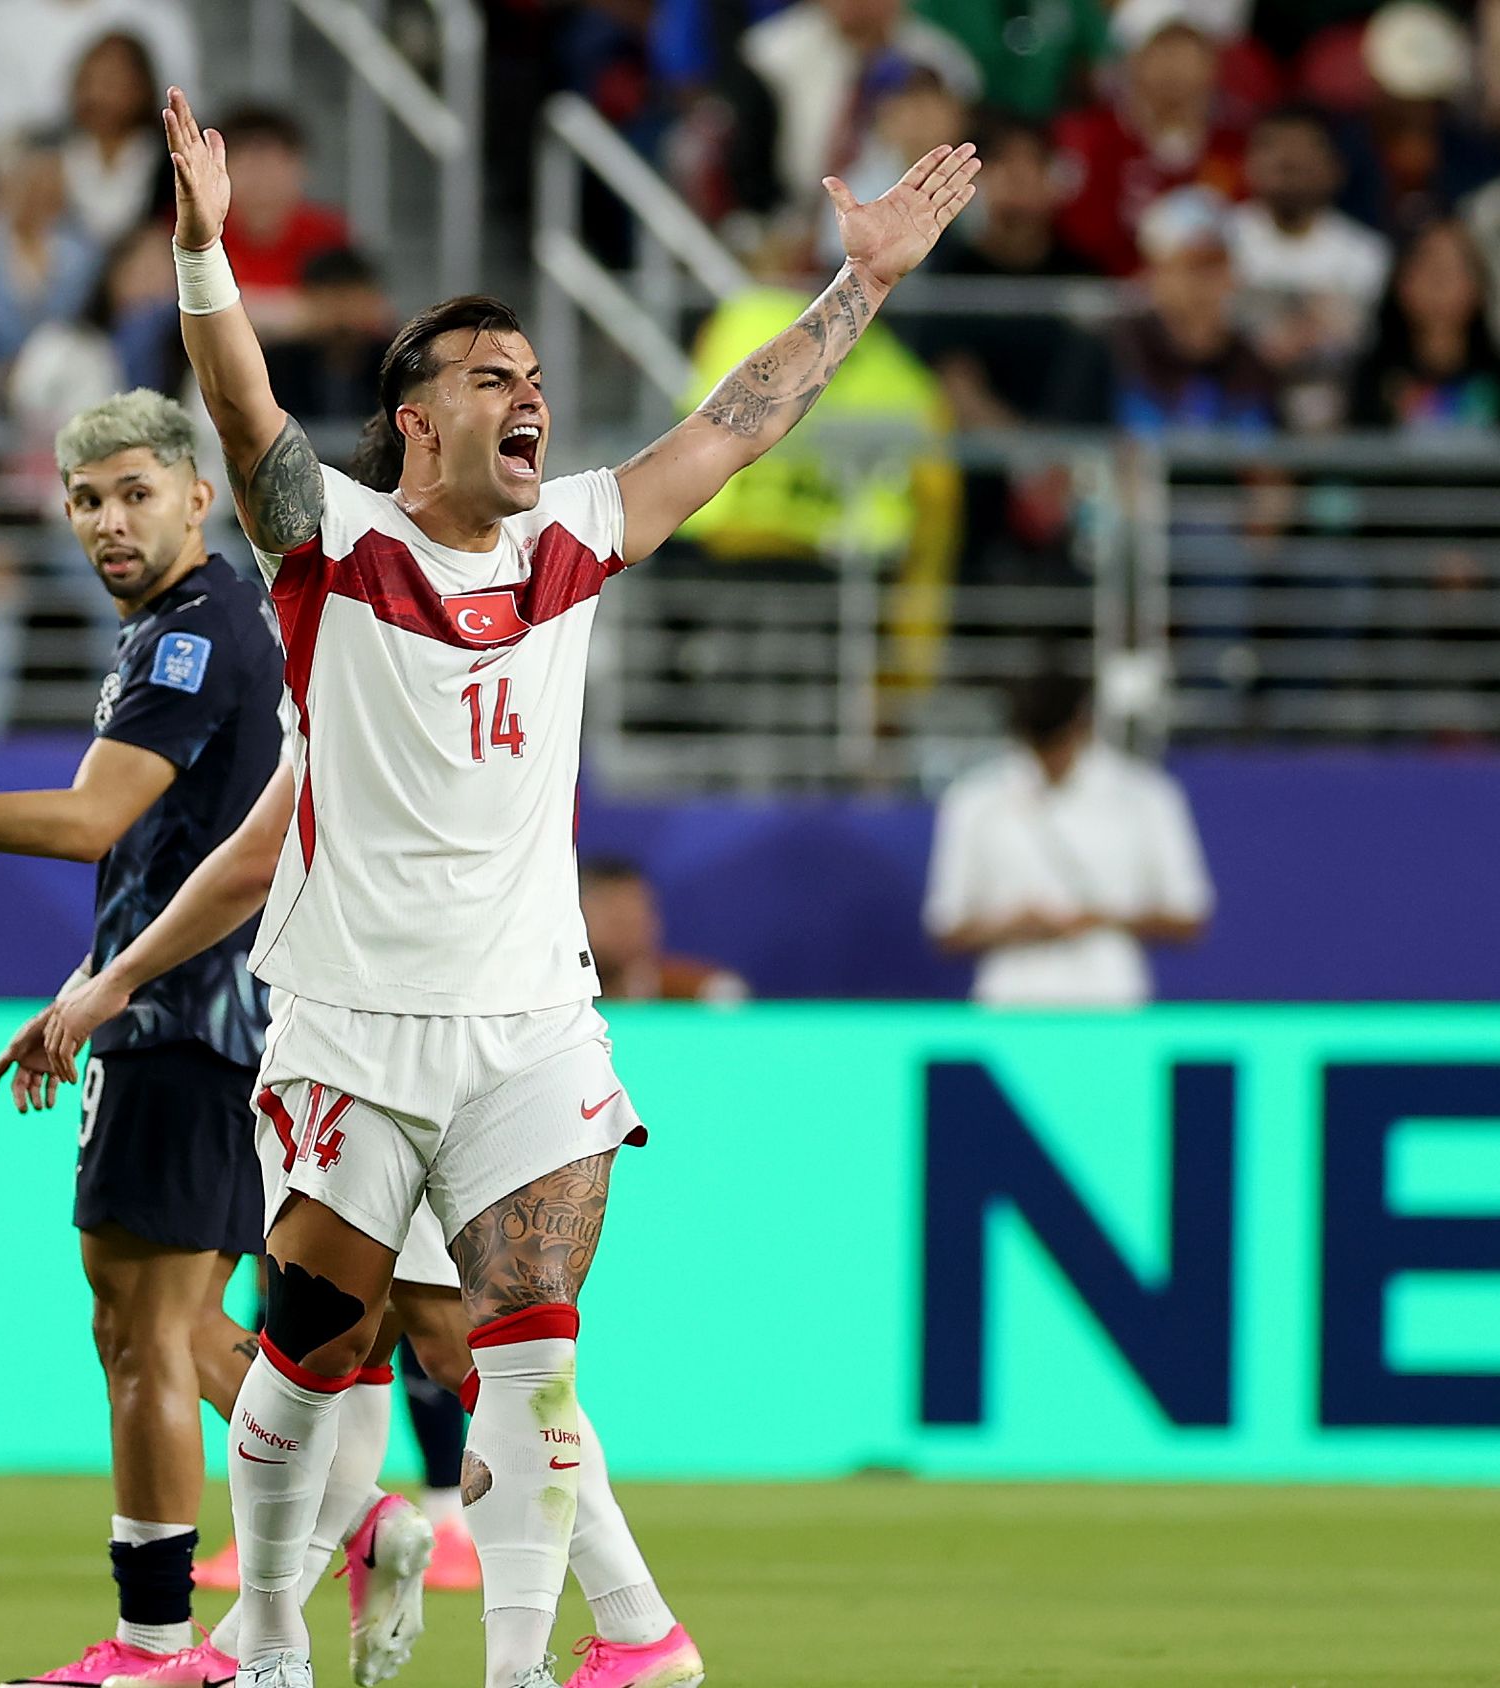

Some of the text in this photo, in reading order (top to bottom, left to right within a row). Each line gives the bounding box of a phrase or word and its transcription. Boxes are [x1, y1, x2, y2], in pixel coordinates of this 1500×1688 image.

[461, 678, 526, 763] 14
[297, 1083, 355, 1172] 14
[502, 1196, 602, 1269] Strong
